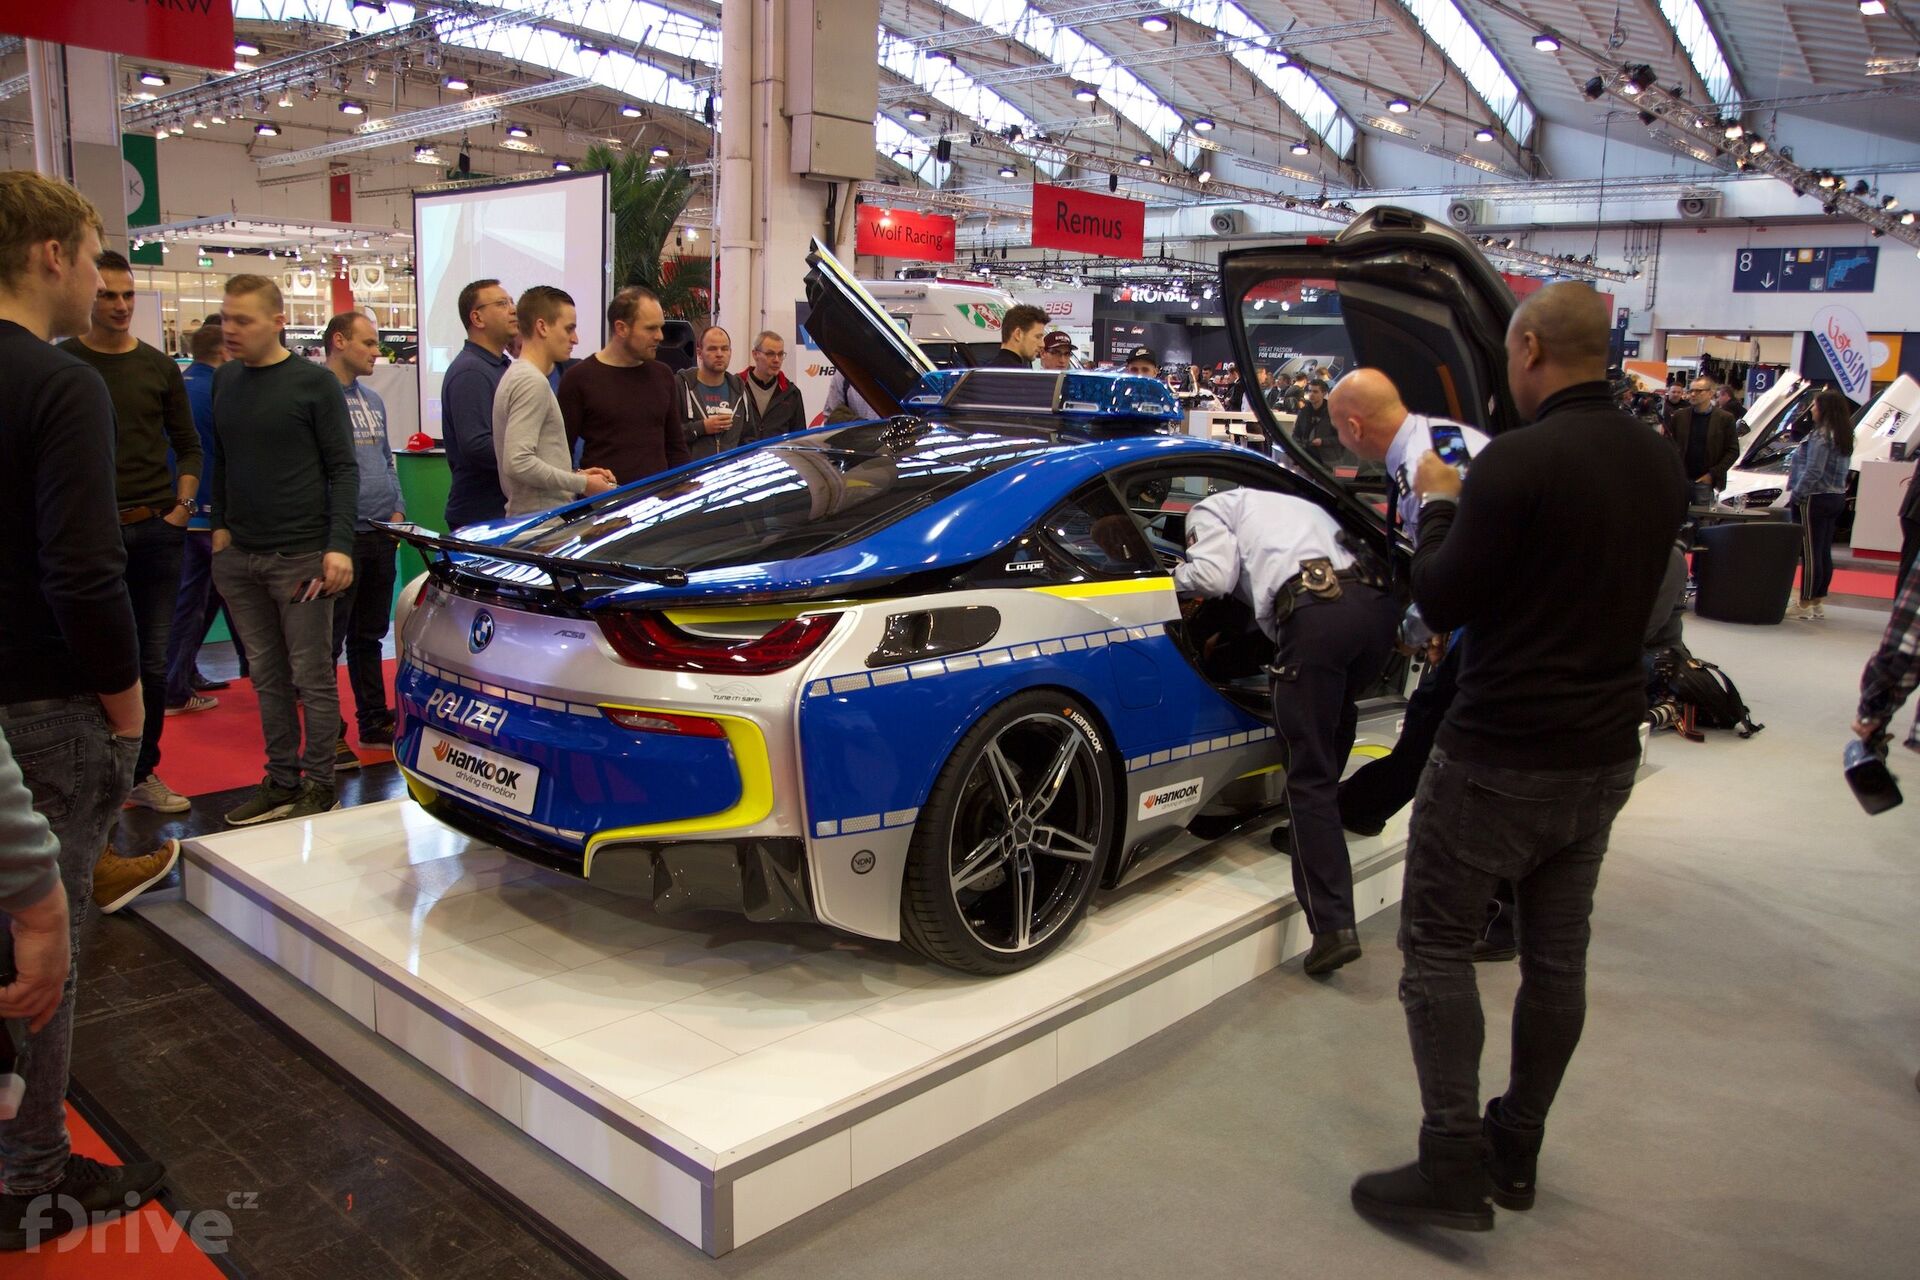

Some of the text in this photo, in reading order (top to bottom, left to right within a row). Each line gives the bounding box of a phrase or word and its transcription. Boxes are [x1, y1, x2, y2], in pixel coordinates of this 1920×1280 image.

[1056, 201, 1122, 240] Remus
[871, 222, 943, 250] Wolf Racing
[1739, 252, 1752, 272] 8
[1131, 287, 1190, 303] RONAL
[1044, 302, 1073, 315] BBS
[1755, 373, 1766, 390] 8
[1005, 560, 1044, 572] Coupe
[425, 688, 509, 736] POLIZEI
[1070, 711, 1103, 754] Hankook
[446, 747, 521, 790] Hankook
[455, 770, 517, 800] driving emotion
[1154, 784, 1199, 806] Hankook
